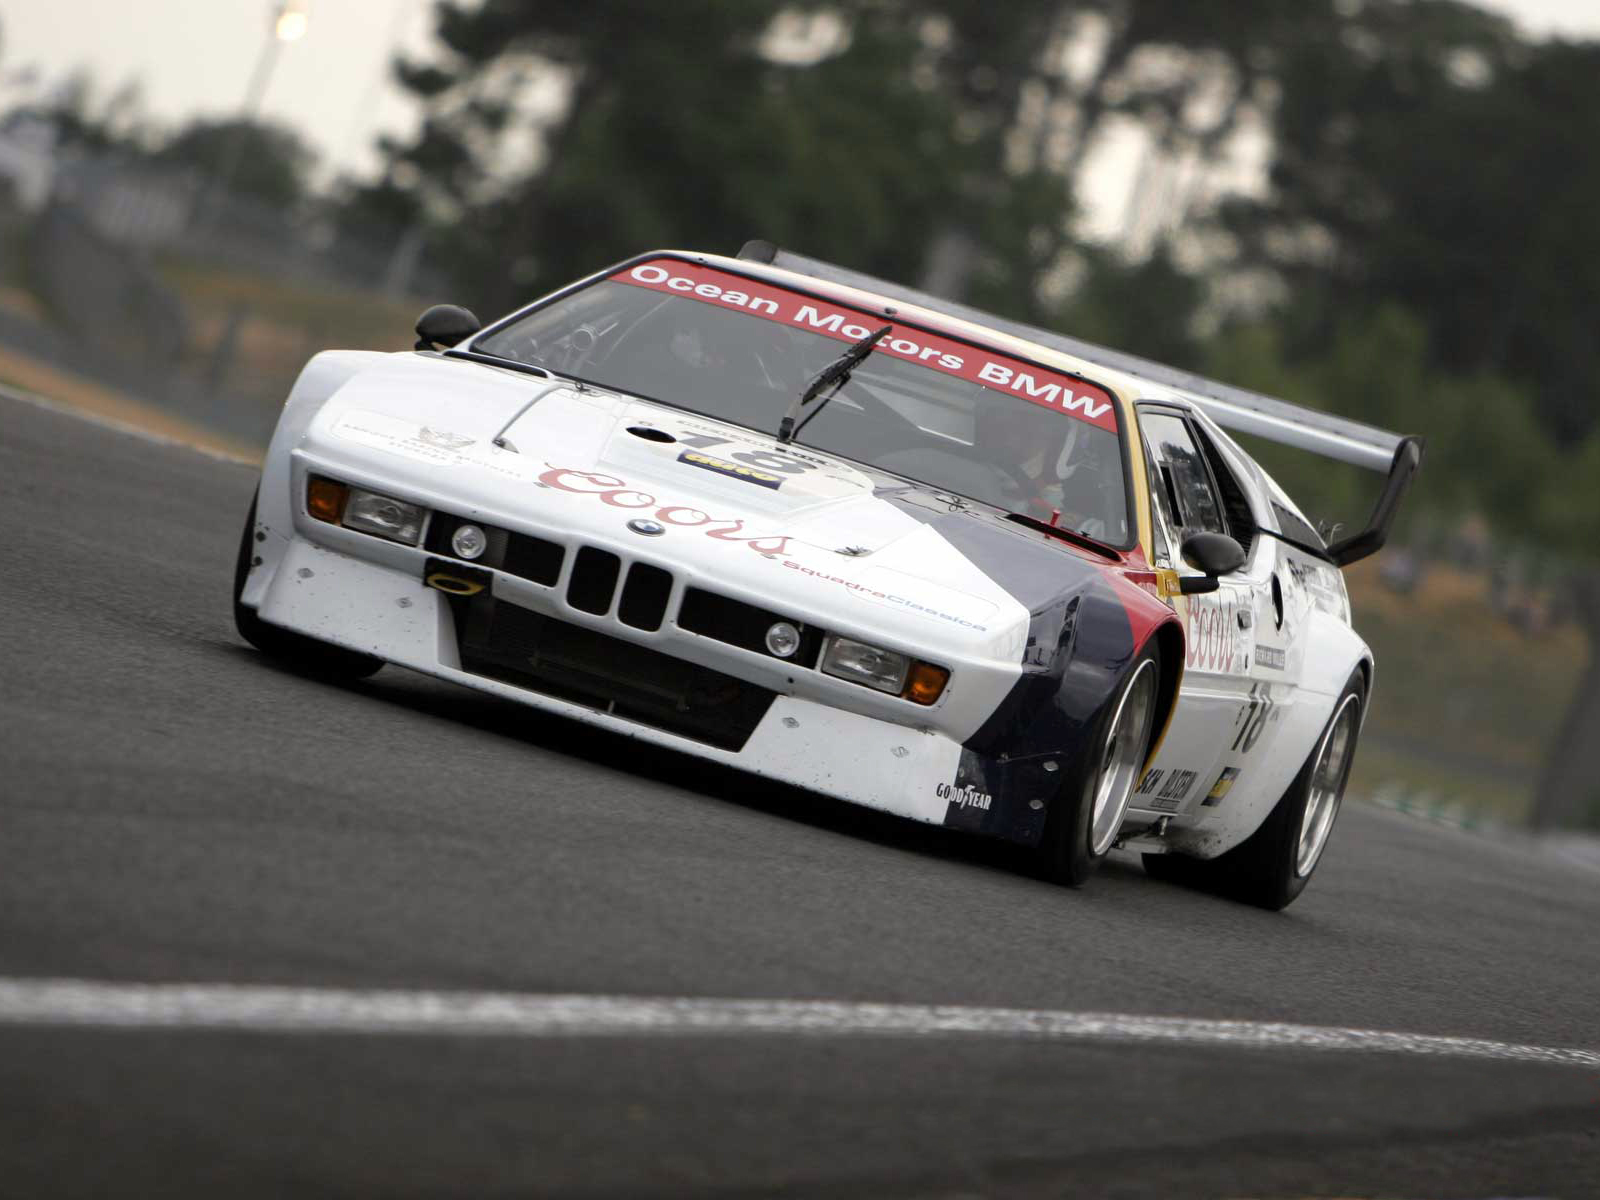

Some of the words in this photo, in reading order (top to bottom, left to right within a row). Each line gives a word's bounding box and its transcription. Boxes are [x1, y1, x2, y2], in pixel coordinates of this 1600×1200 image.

[629, 265, 778, 315] Ocean
[977, 361, 1112, 420] BMW
[676, 430, 819, 475] 18
[538, 462, 793, 557] Coors
